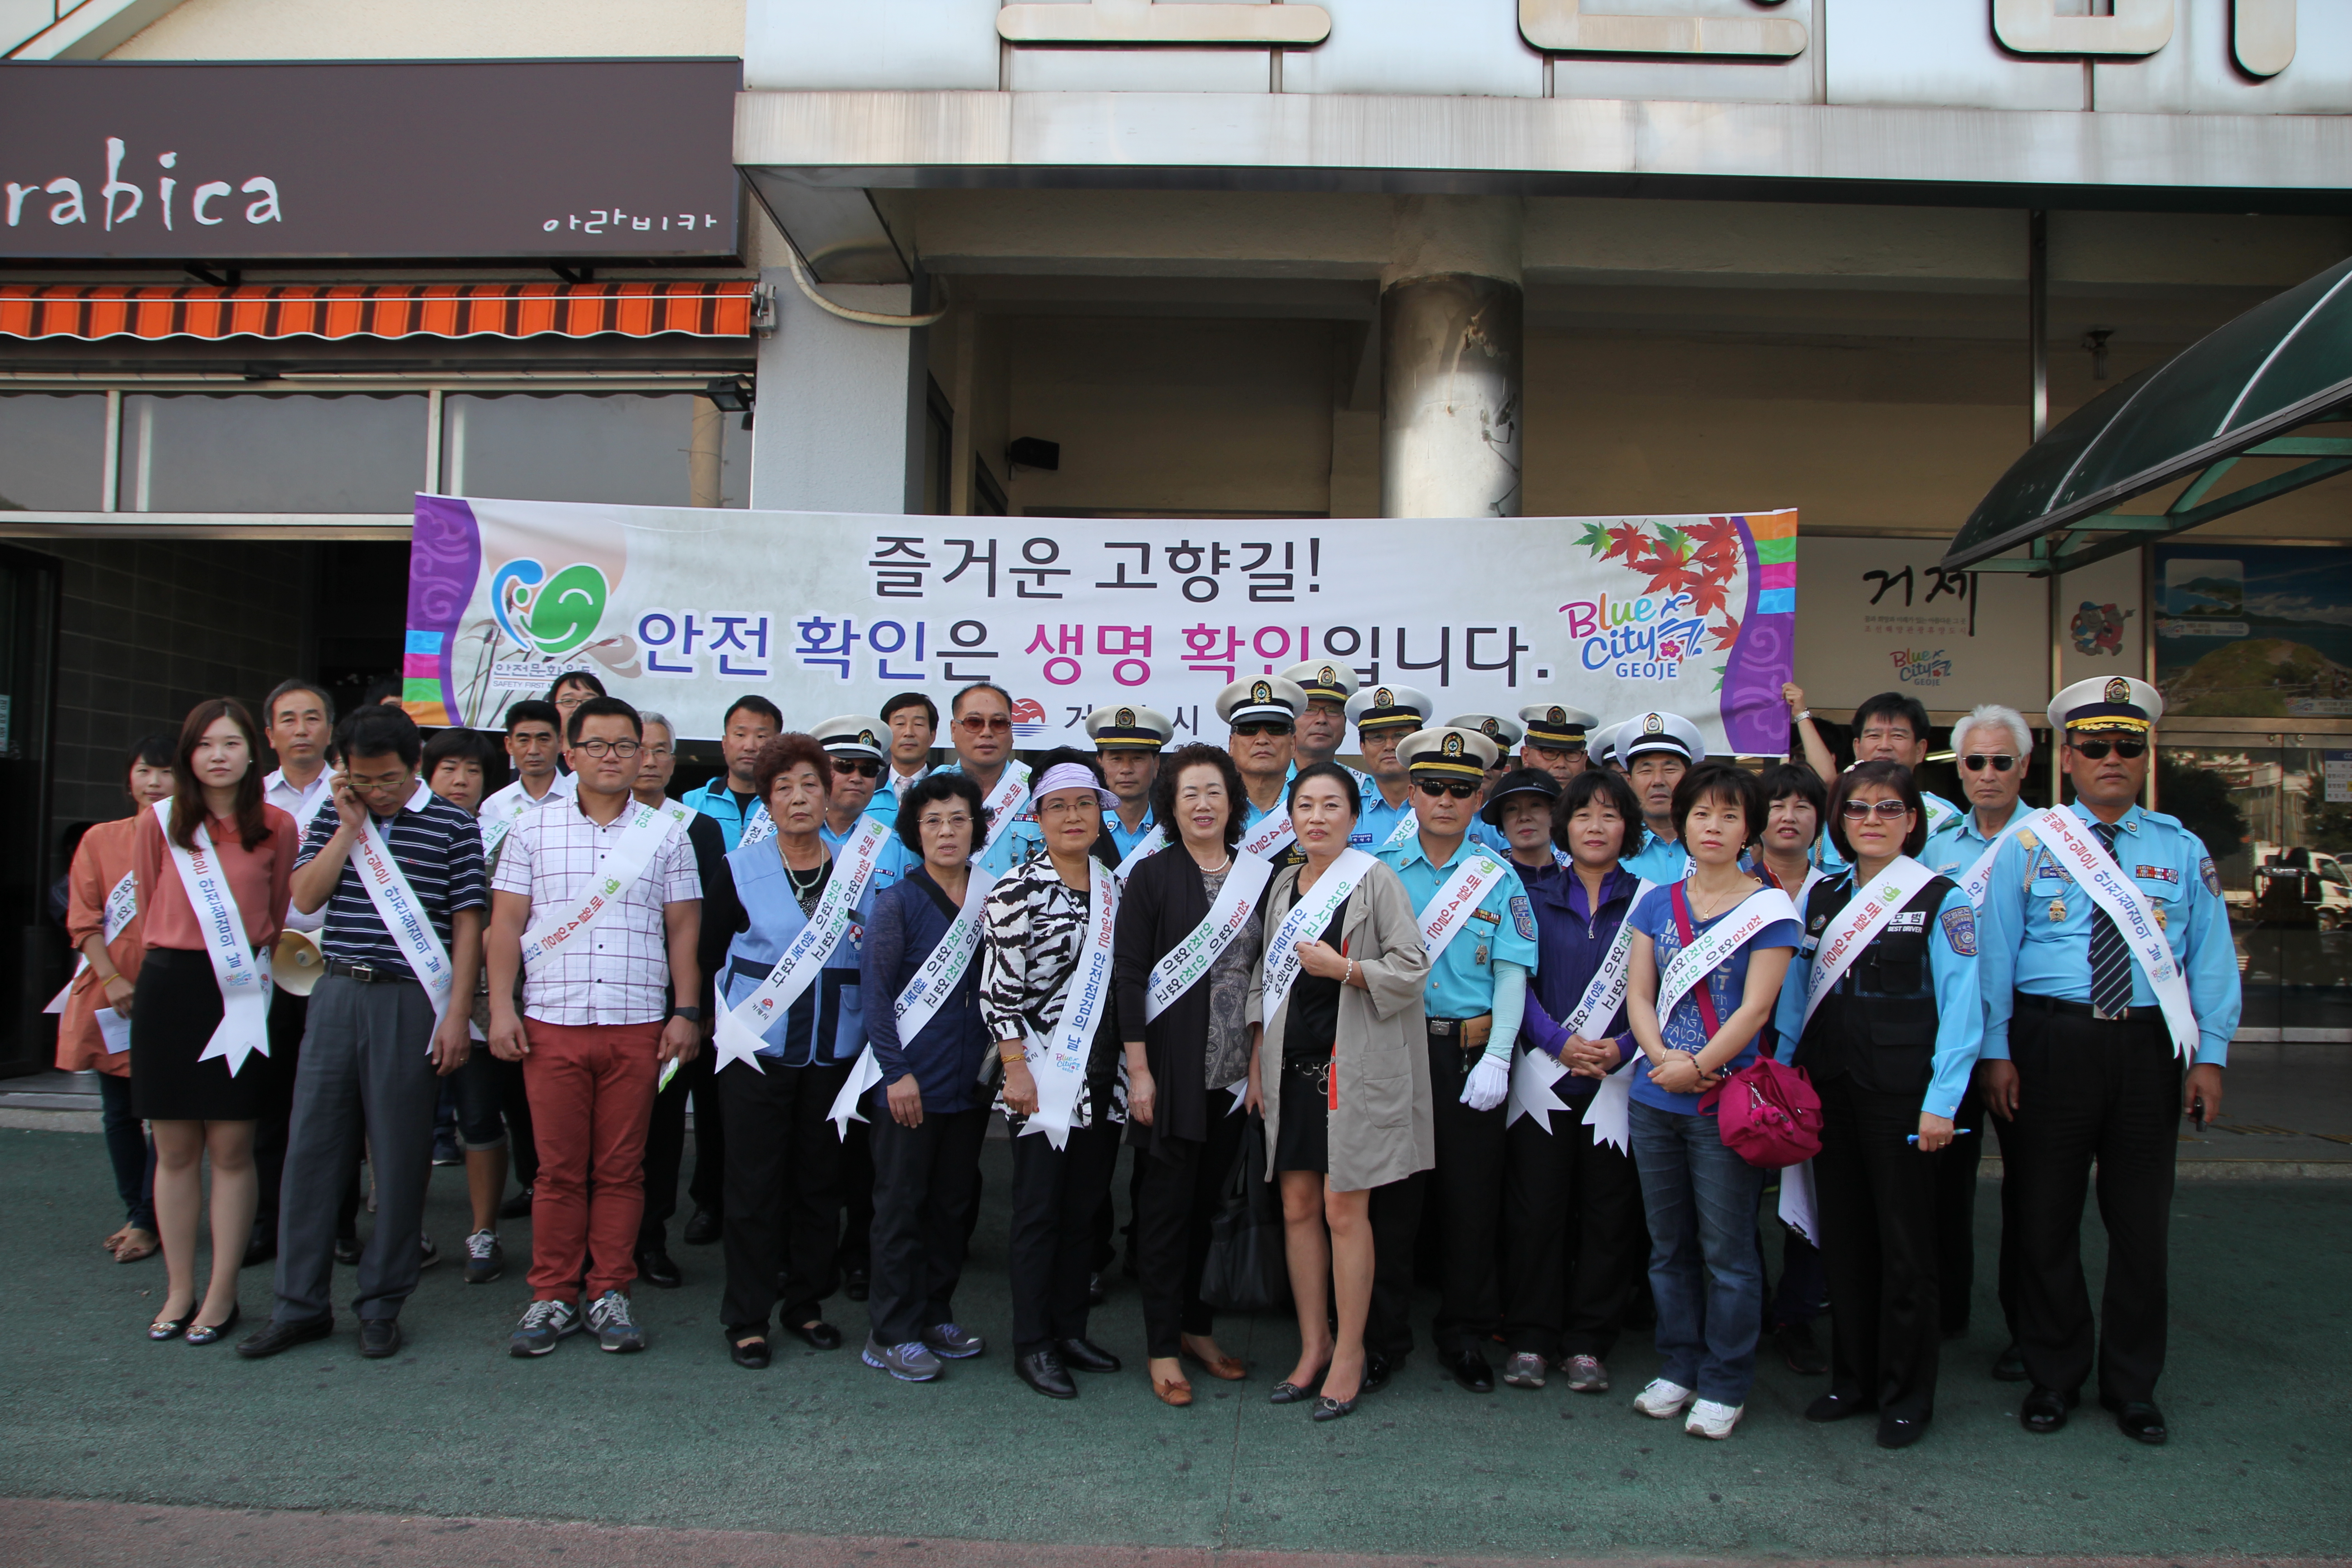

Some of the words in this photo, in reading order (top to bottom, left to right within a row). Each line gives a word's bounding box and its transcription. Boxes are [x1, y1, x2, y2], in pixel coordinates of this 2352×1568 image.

[543, 209, 718, 233] 아라비카
[869, 536, 1072, 598] 즐거운
[1095, 537, 1322, 602] 고향길!
[1559, 593, 1657, 639] Blue
[1862, 565, 1978, 637] 거제
[494, 664, 596, 677] 안전문화
[638, 612, 768, 676] 안전
[795, 616, 1000, 682] 확인은
[1025, 622, 1154, 686] 생명
[1181, 623, 1548, 687] 확인입니다.
[1582, 626, 1655, 670] City
[1616, 663, 1677, 680] GEOJE
[1890, 648, 1930, 667] Blue
[1900, 662, 1931, 681] City
[1064, 704, 1198, 735] 거시
[1001, 783, 1022, 808] 매월
[816, 879, 843, 930] 안전없이
[844, 858, 871, 906] 점검없이
[1100, 879, 1113, 907] 매월
[1456, 874, 1483, 903] 매월
[2042, 812, 2068, 834] 매월
[2064, 831, 2099, 870] 4일은
[2094, 870, 2152, 940] 안전점검의
[2146, 943, 2163, 961] 날
[199, 878, 236, 947] 안전점검의
[225, 952, 242, 968] 날
[364, 843, 391, 885] 4일은
[384, 886, 431, 954] 안전점검의
[425, 956, 441, 973] 날
[577, 895, 605, 924] 매월
[1098, 906, 1112, 949] 4일은
[1209, 899, 1250, 955] 점검없이
[1302, 882, 1351, 938] 안전사고
[1426, 900, 1460, 940] 4일은
[1852, 902, 1883, 932] 매월
[541, 921, 579, 951] 4일은
[811, 907, 848, 962] 안전없고
[927, 919, 967, 978] 안전없이
[1163, 922, 1214, 976] 안전없이
[1268, 909, 1308, 968] 안전문화
[1706, 915, 1764, 966] 점검없이
[1822, 930, 1856, 969] 4일은
[771, 931, 817, 988] 행복없다
[923, 951, 967, 1009] 안전없고
[1155, 954, 1208, 1005] 안전없고
[1275, 941, 1300, 1000] 방하여
[1665, 936, 1715, 989] 안전없이
[894, 977, 927, 1020] 행복없
[1072, 952, 1107, 1031] 안전점검의
[1055, 1053, 1073, 1062] Blue
[1067, 1034, 1083, 1052] 날
